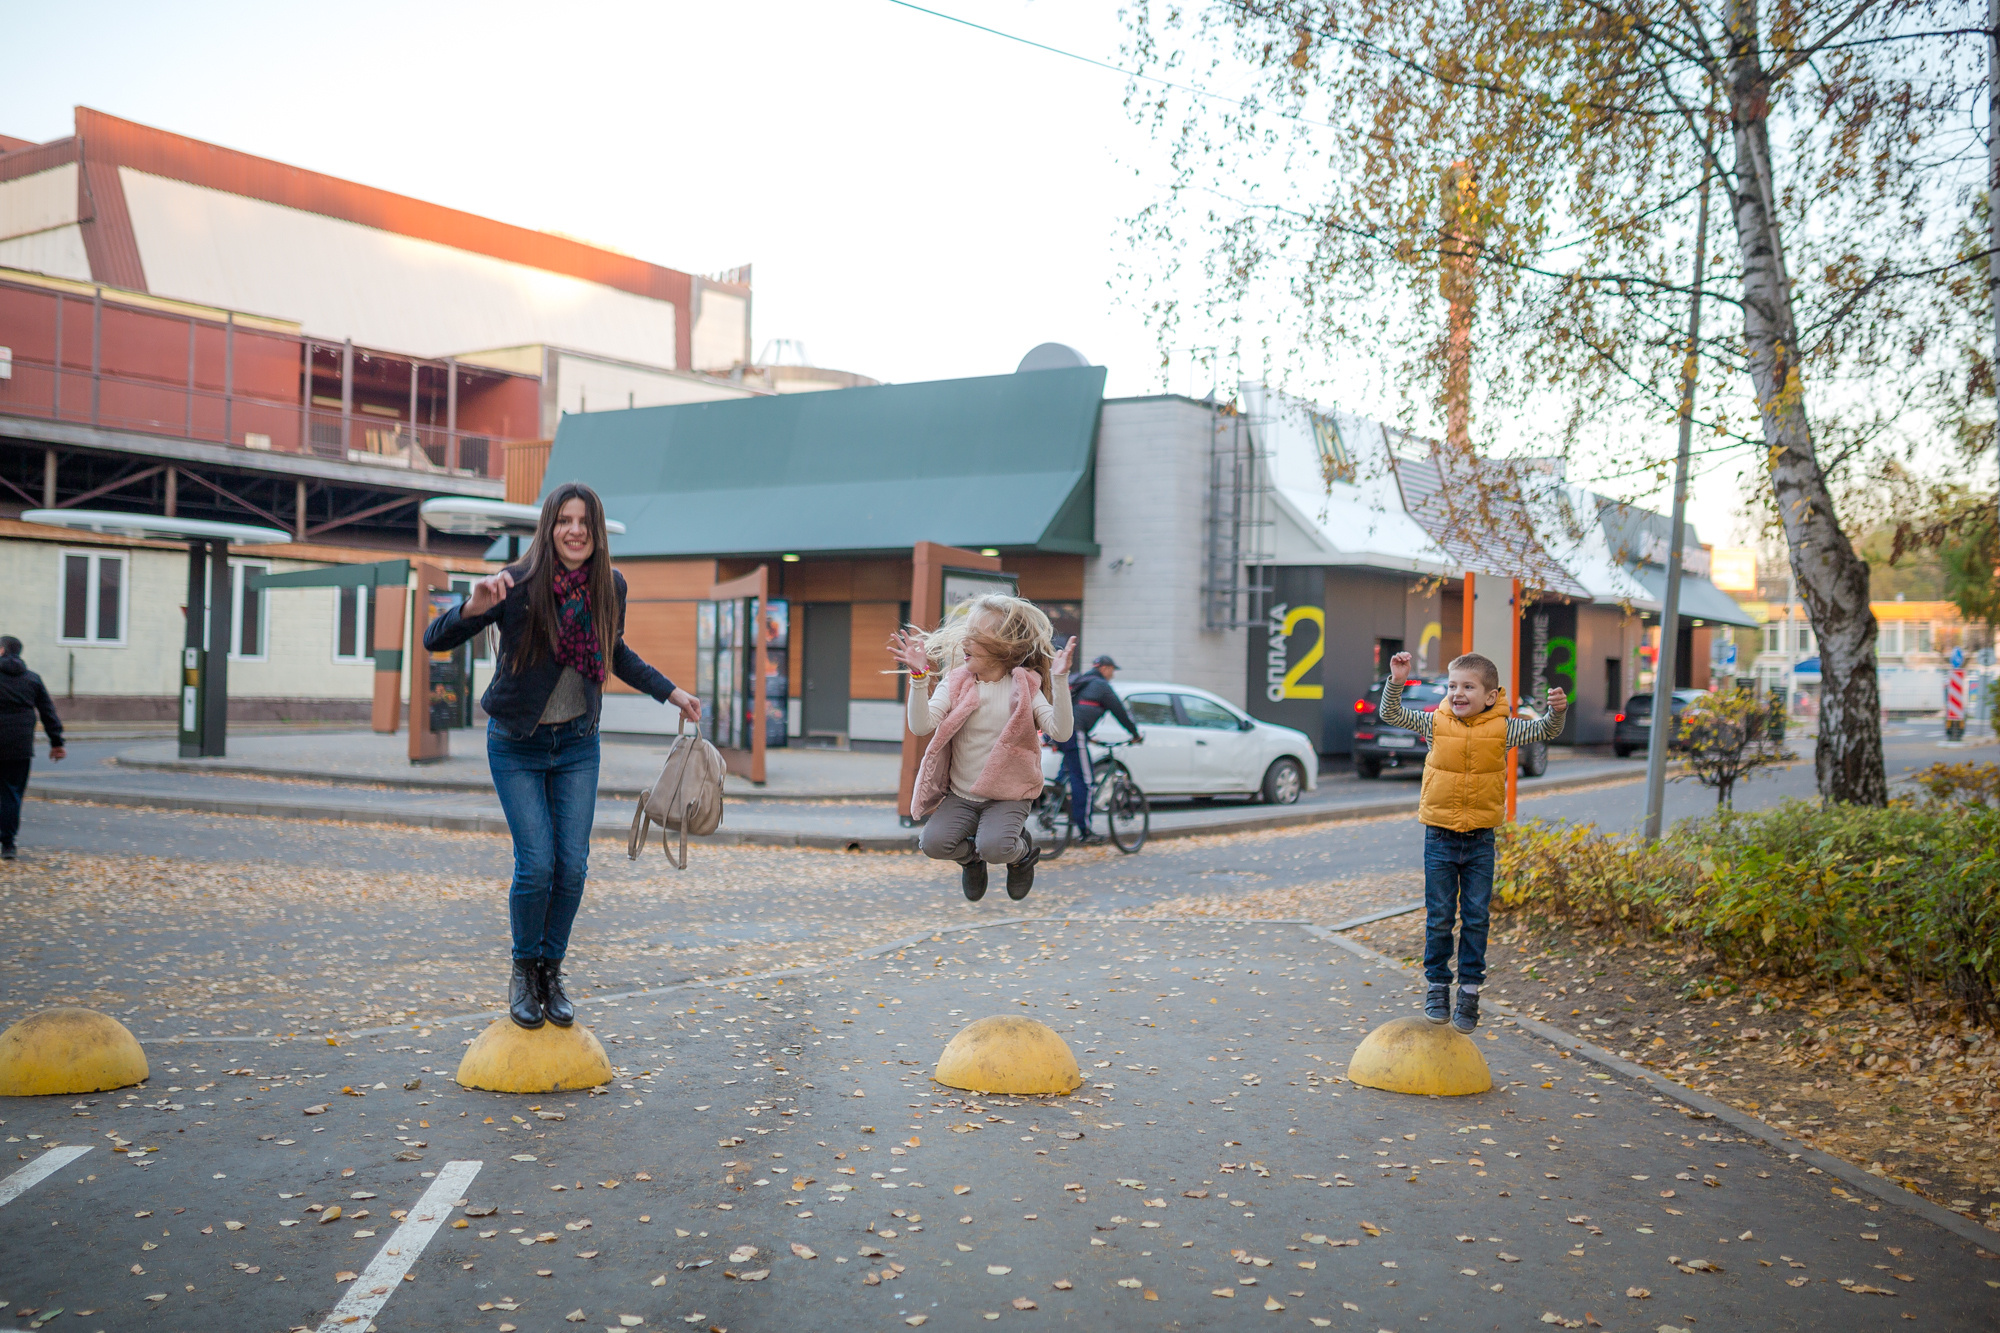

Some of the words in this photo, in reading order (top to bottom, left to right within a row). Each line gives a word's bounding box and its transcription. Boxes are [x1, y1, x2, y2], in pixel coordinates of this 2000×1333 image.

[1267, 602, 1288, 702] ОПЛАТА
[1281, 605, 1325, 699] 2
[1533, 613, 1549, 716] ОЛУЧЕНИЕ
[1546, 636, 1577, 705] 3
